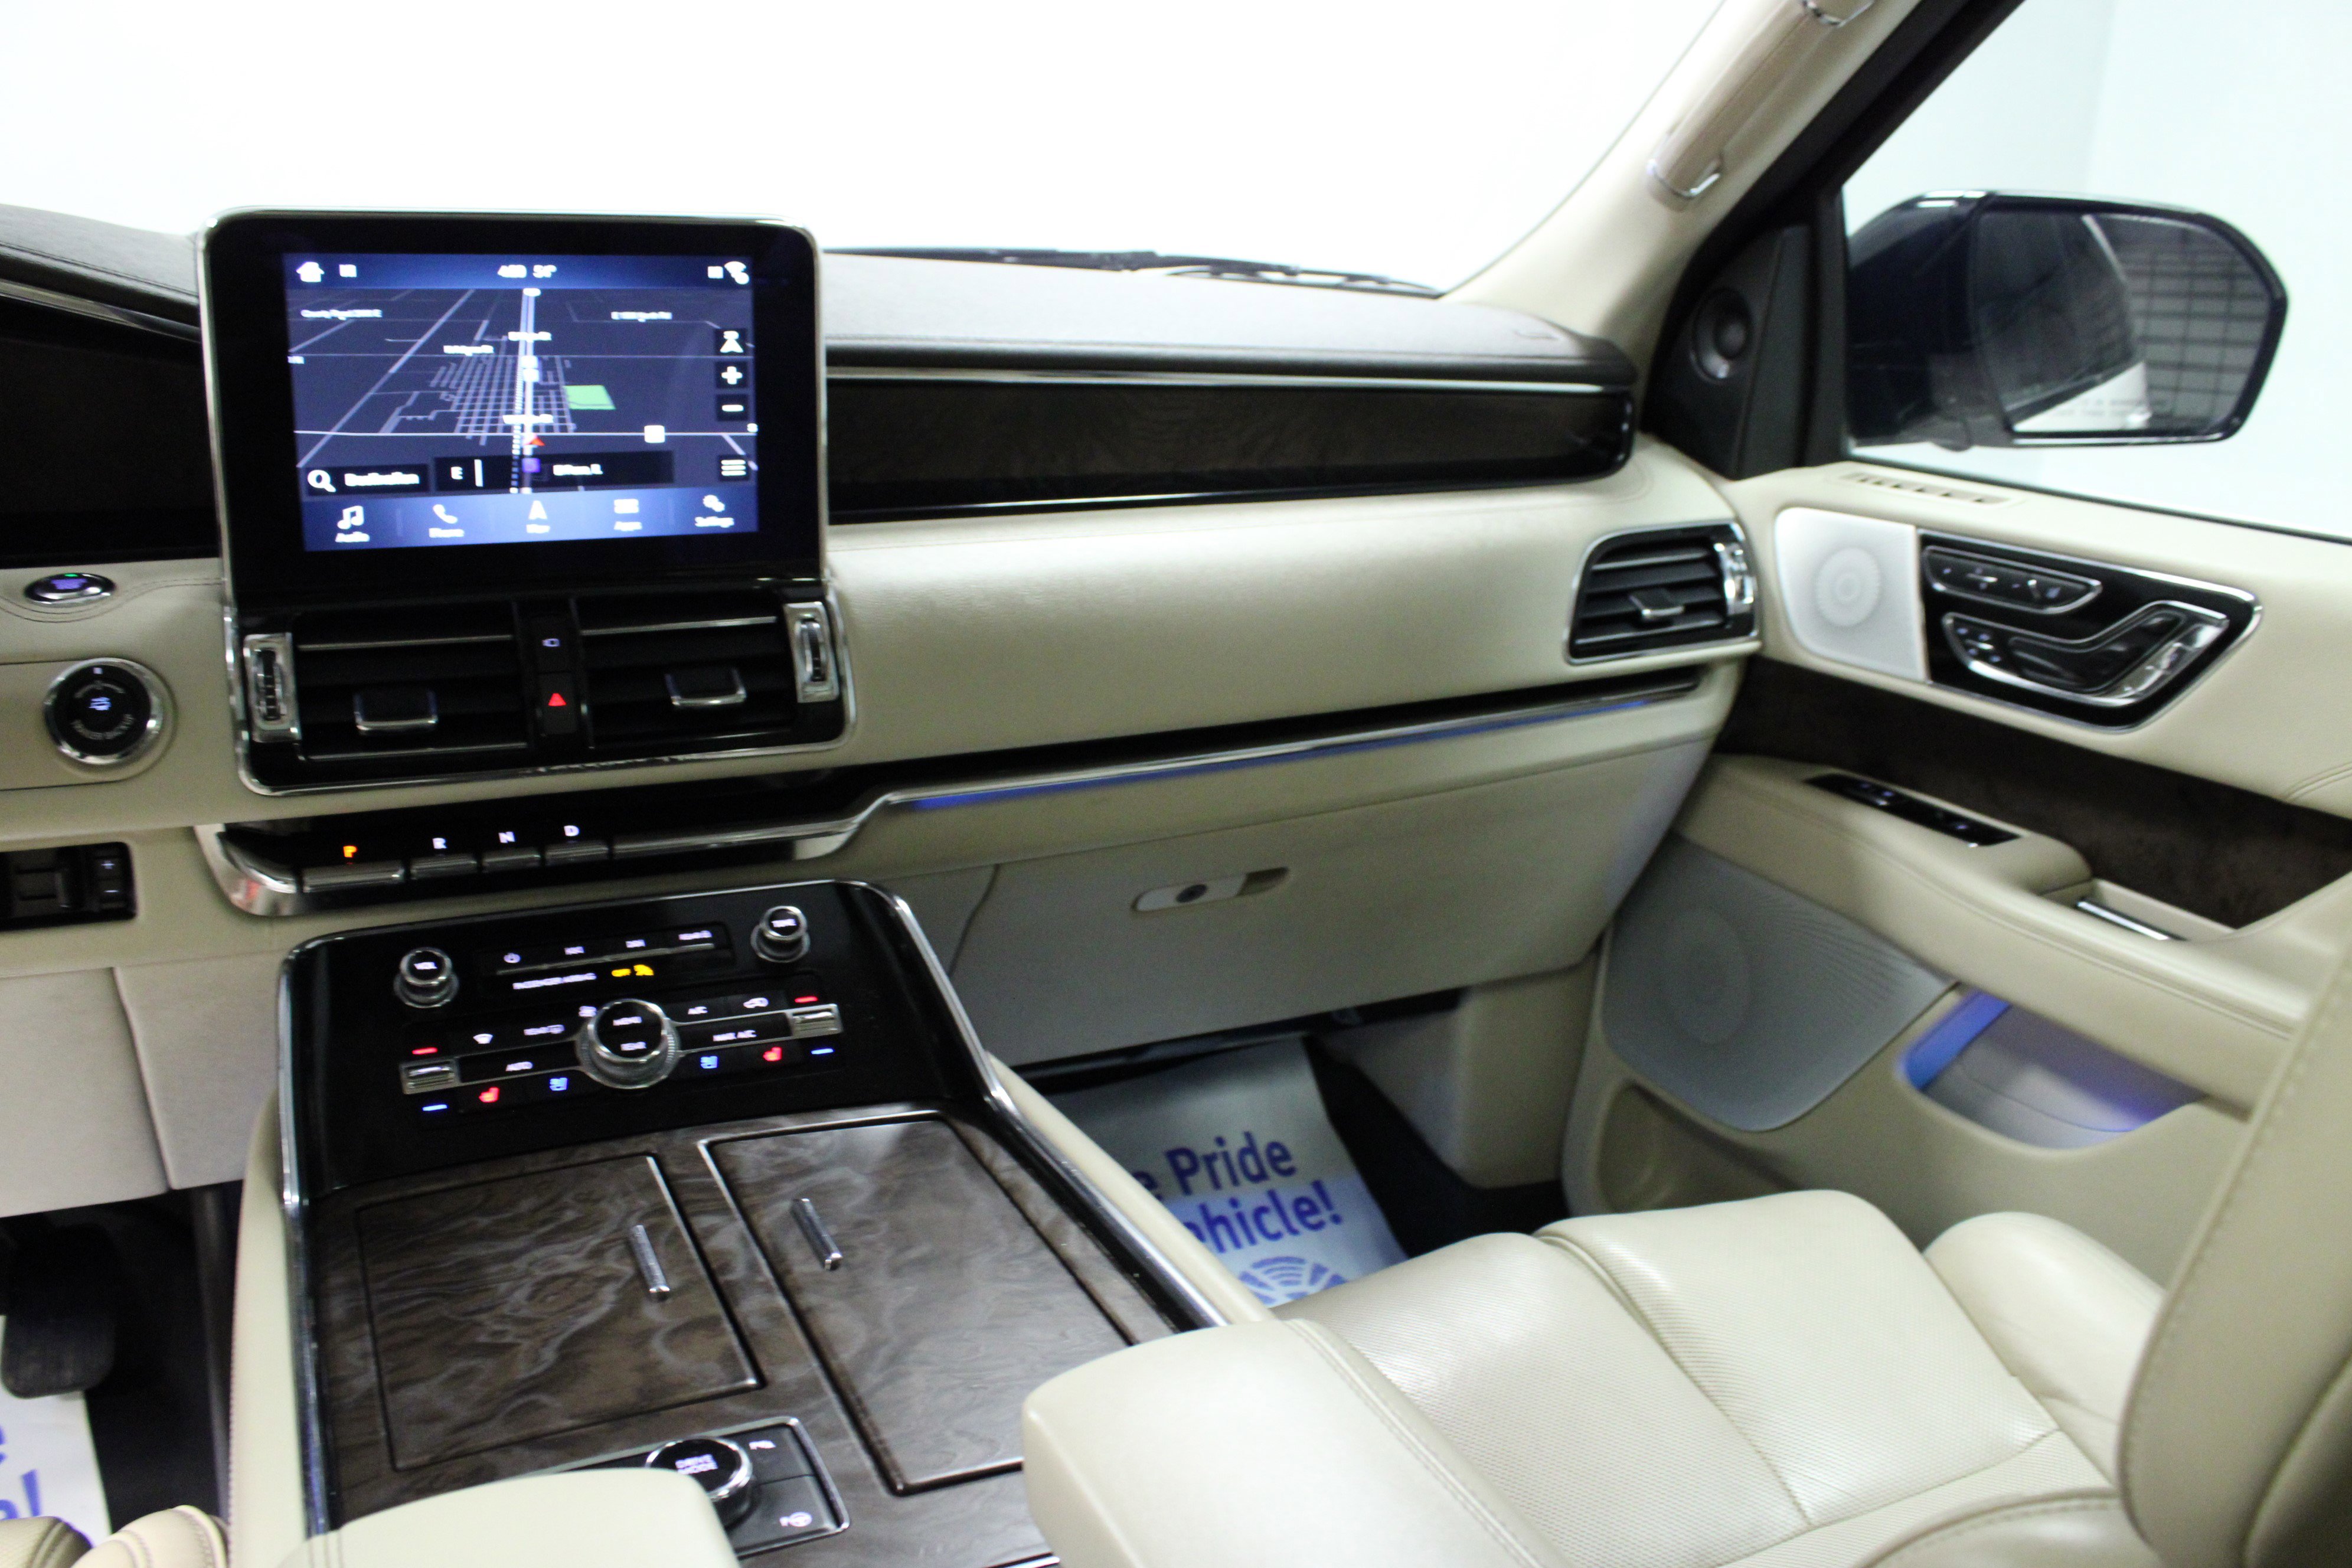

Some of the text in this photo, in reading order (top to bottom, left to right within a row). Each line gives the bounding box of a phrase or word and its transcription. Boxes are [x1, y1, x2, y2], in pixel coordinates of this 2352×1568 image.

[498, 831, 515, 843] N
[564, 825, 580, 837] D
[432, 837, 447, 849] R
[343, 845, 358, 858] P
[1165, 1131, 1297, 1196] Pride
